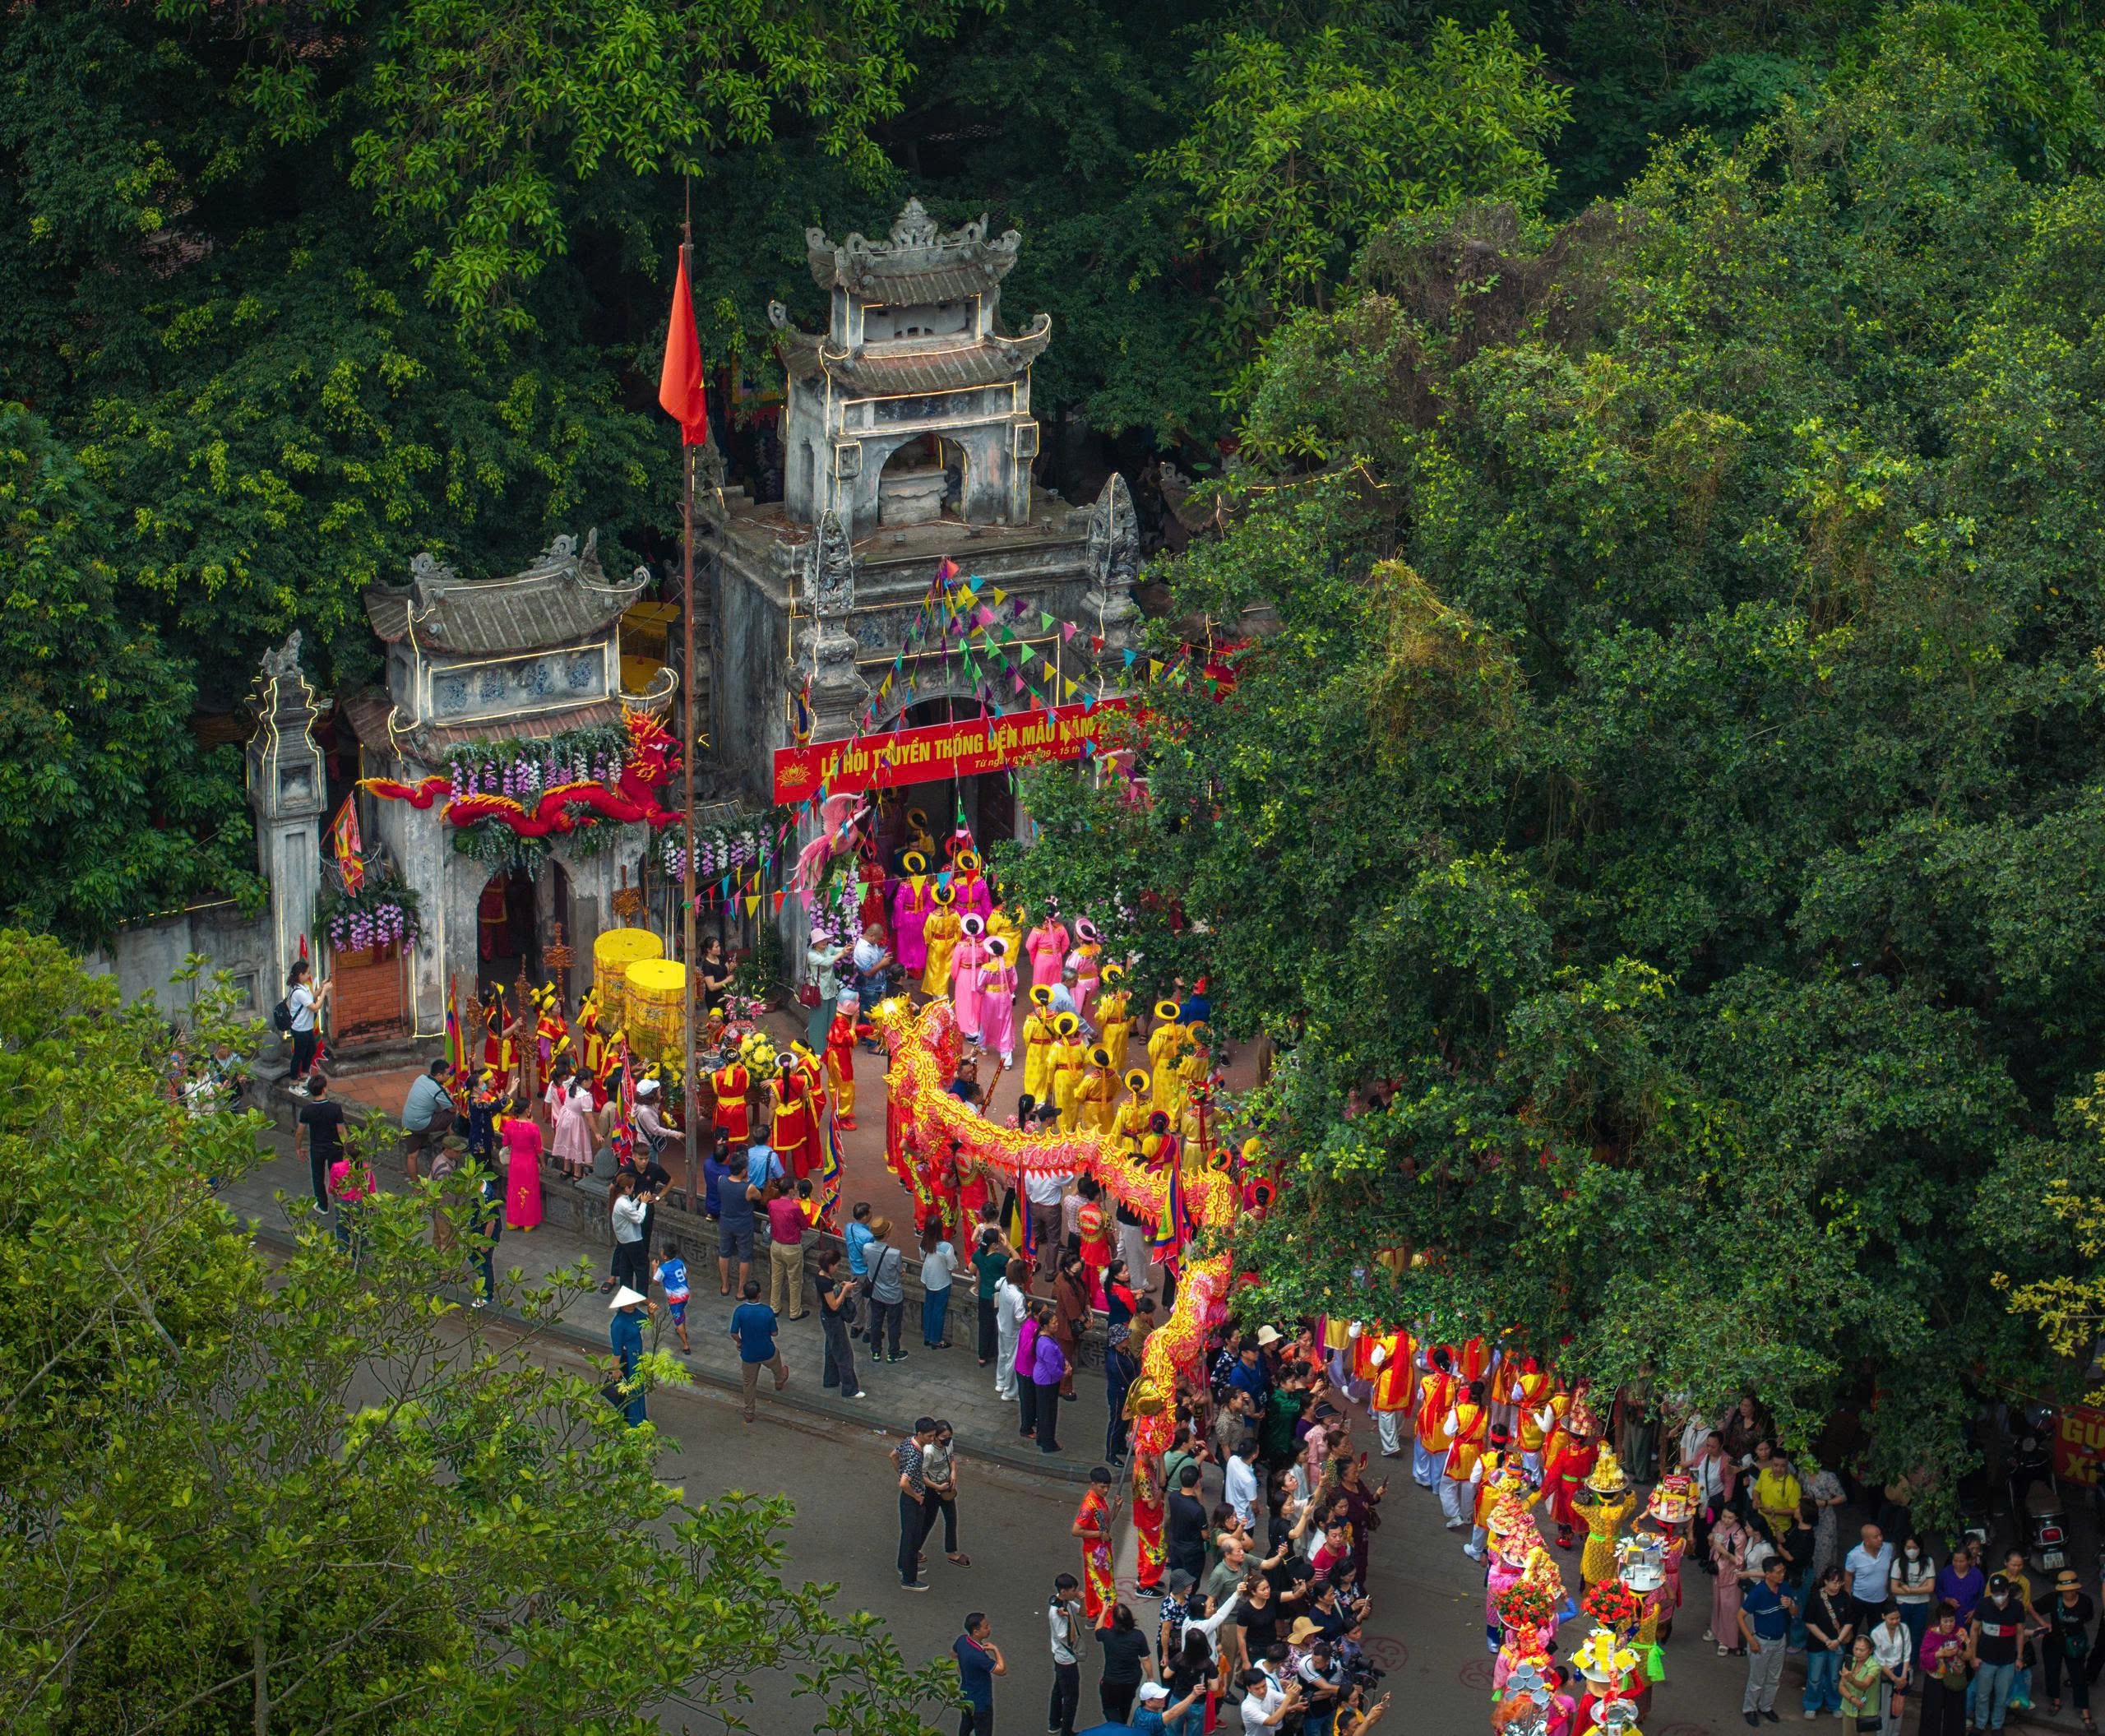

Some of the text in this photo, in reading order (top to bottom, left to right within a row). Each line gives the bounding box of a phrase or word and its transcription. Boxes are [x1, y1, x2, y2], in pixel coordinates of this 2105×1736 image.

[821, 748, 839, 777] LỄ
[843, 748, 869, 776] HỘI
[872, 737, 931, 770] TRUYỀN
[935, 730, 983, 758] THỐNG
[988, 724, 1018, 752] ĐỀN
[1022, 717, 1056, 747] MẪU
[1060, 714, 1095, 741] NĂM
[975, 758, 988, 769] Từ
[1059, 746, 1070, 756] 15
[674, 1268, 686, 1283] 9
[2061, 1414, 2105, 1449] GỬ
